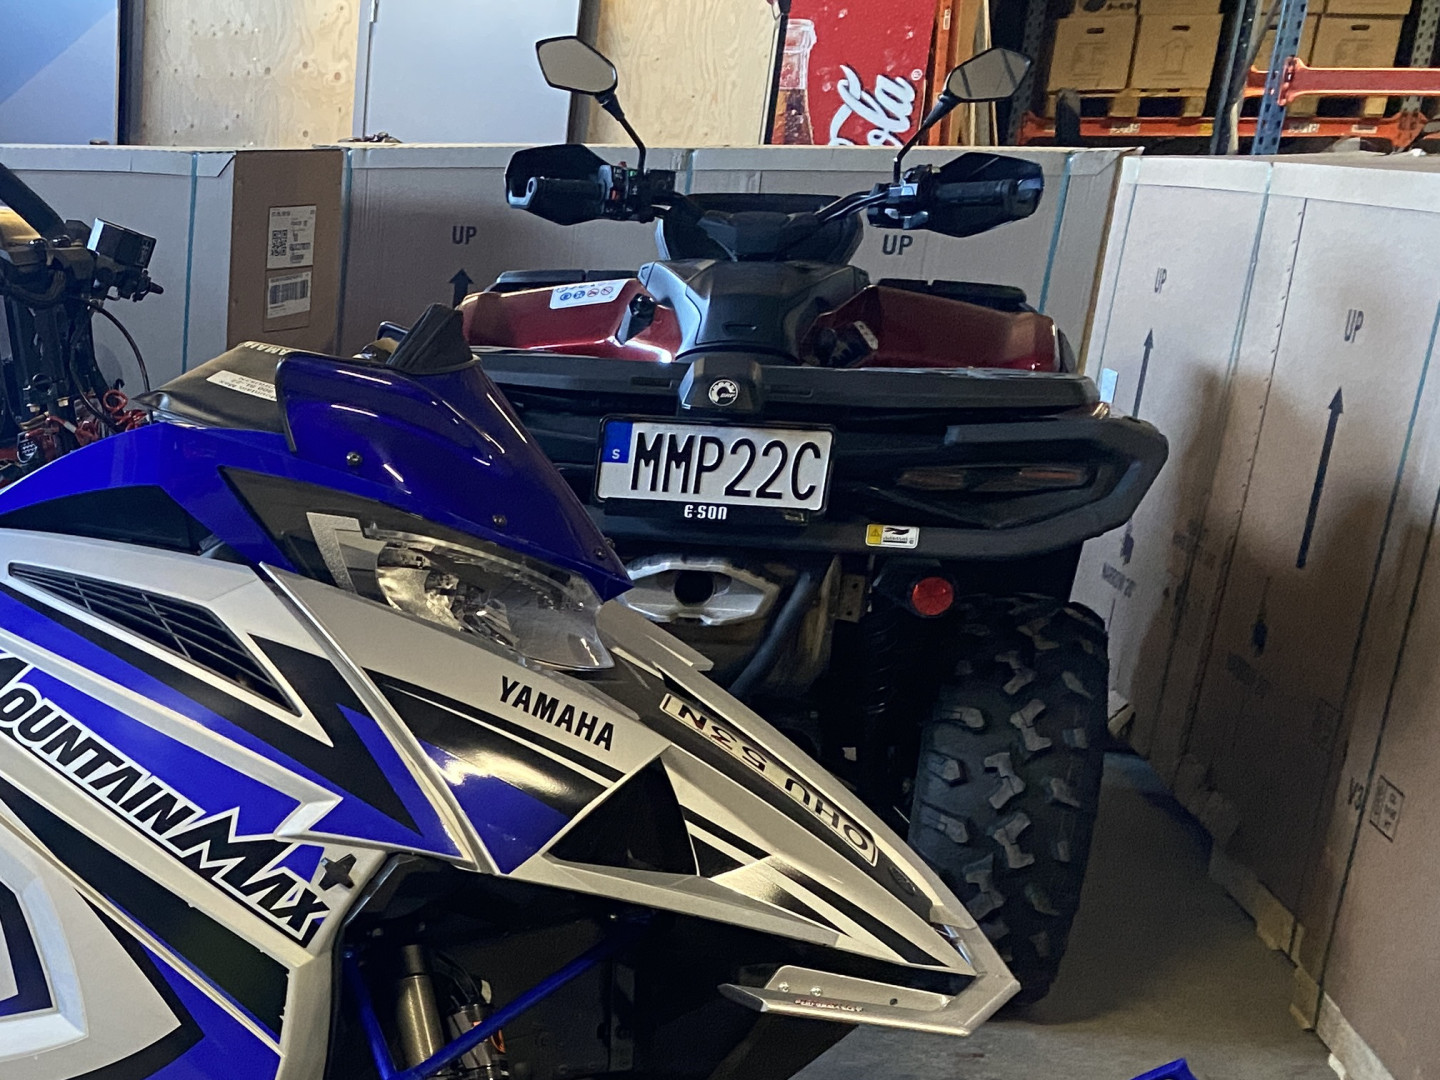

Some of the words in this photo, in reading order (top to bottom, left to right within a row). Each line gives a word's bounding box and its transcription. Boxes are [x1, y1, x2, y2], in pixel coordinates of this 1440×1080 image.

[452, 225, 477, 245] UP
[882, 234, 914, 256] UP
[1154, 267, 1167, 294] UP
[1344, 308, 1365, 344] UP
[611, 448, 621, 460] S
[631, 432, 822, 501] MMP22C
[500, 675, 614, 752] YAMAHA
[165, 807, 330, 939] MAX
